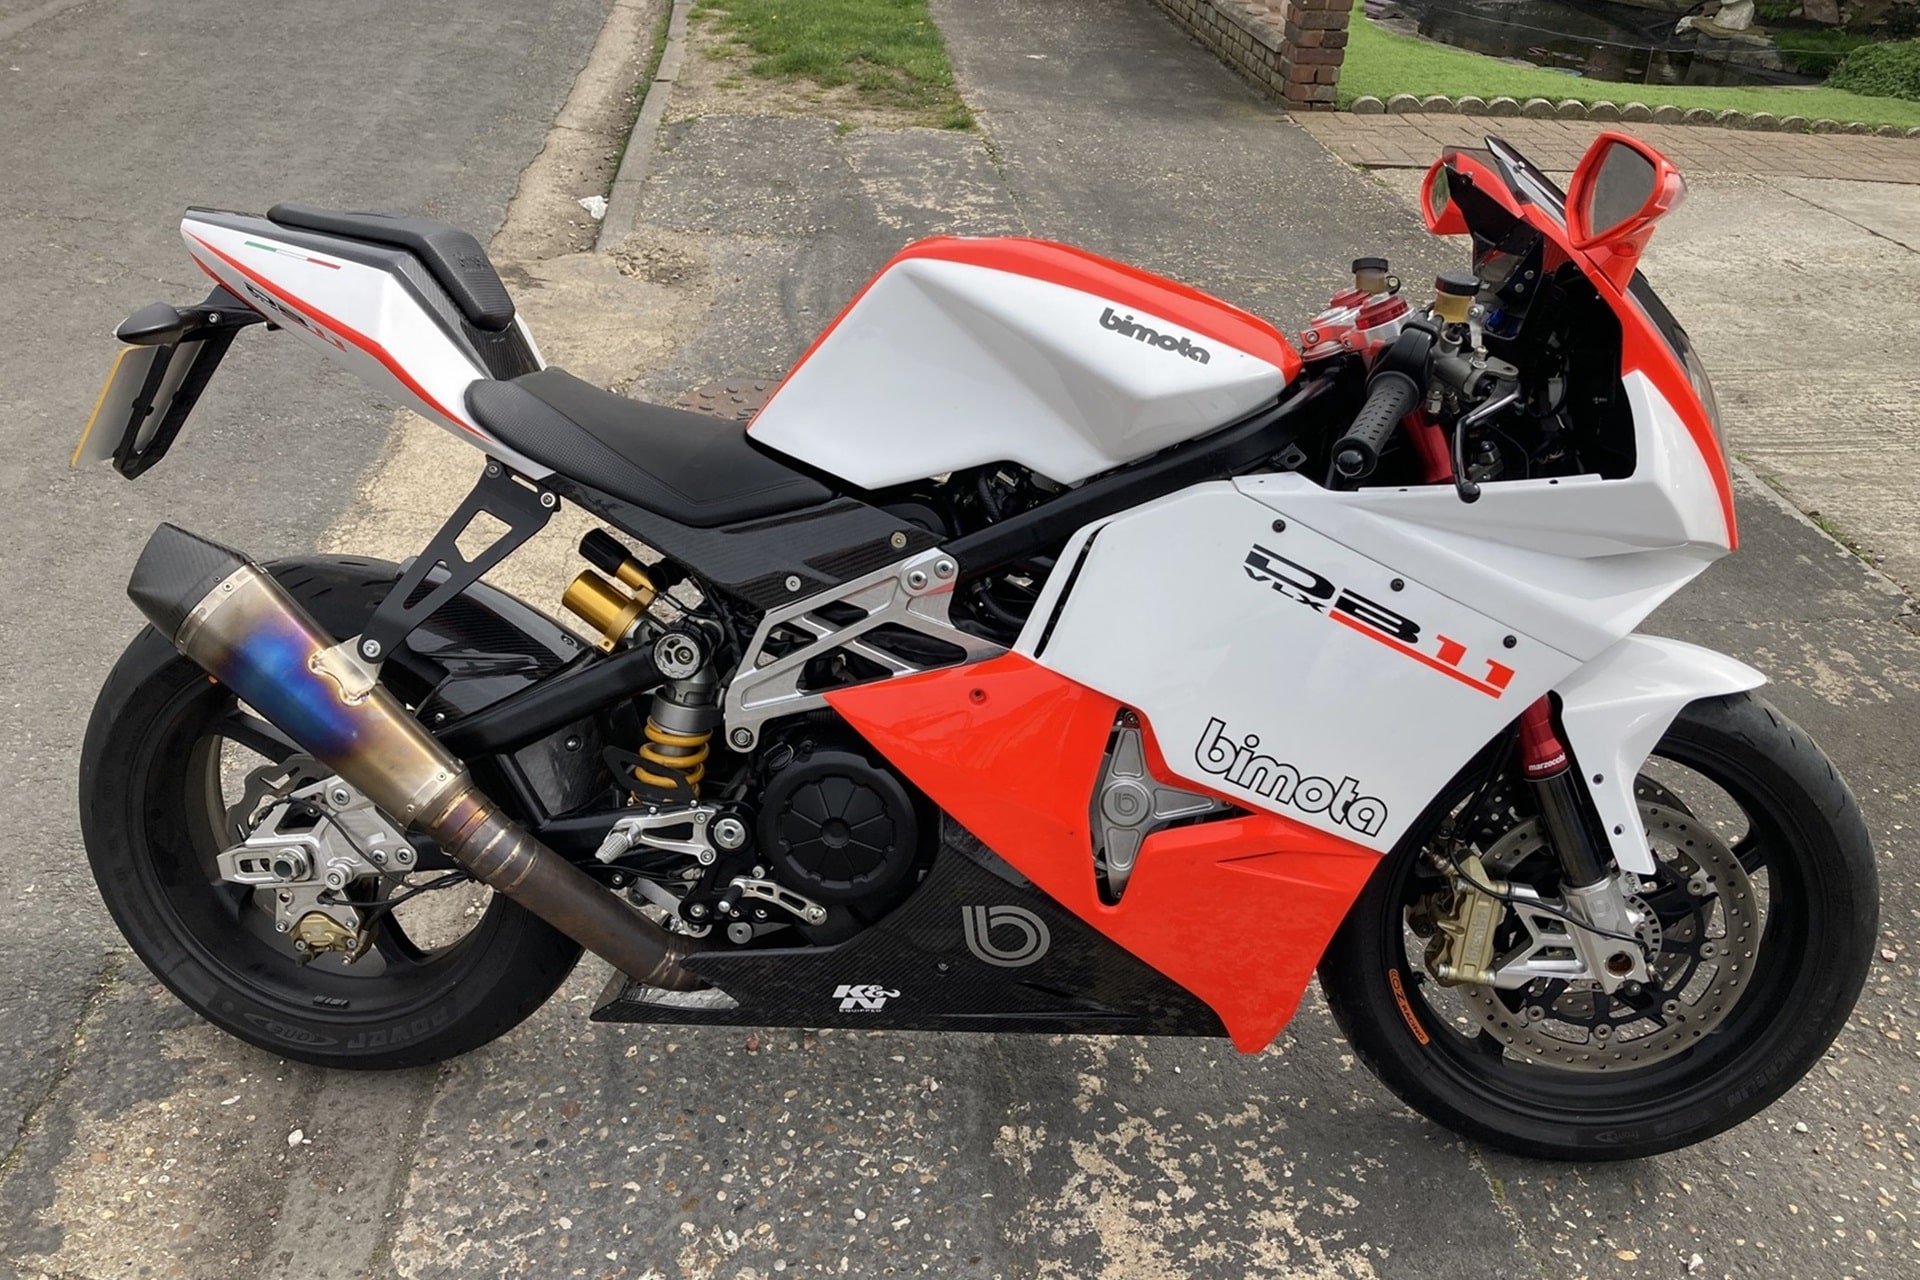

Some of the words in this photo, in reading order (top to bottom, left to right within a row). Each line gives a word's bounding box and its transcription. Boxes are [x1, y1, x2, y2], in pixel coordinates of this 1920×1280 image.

[1099, 307, 1211, 365] bimota
[1243, 565, 1327, 614] VLX
[1195, 716, 1388, 838] bimota
[1528, 752, 1566, 771] marzocchi
[1401, 1005, 1425, 1041] RACING
[1726, 1034, 1806, 1109] MICHELIN
